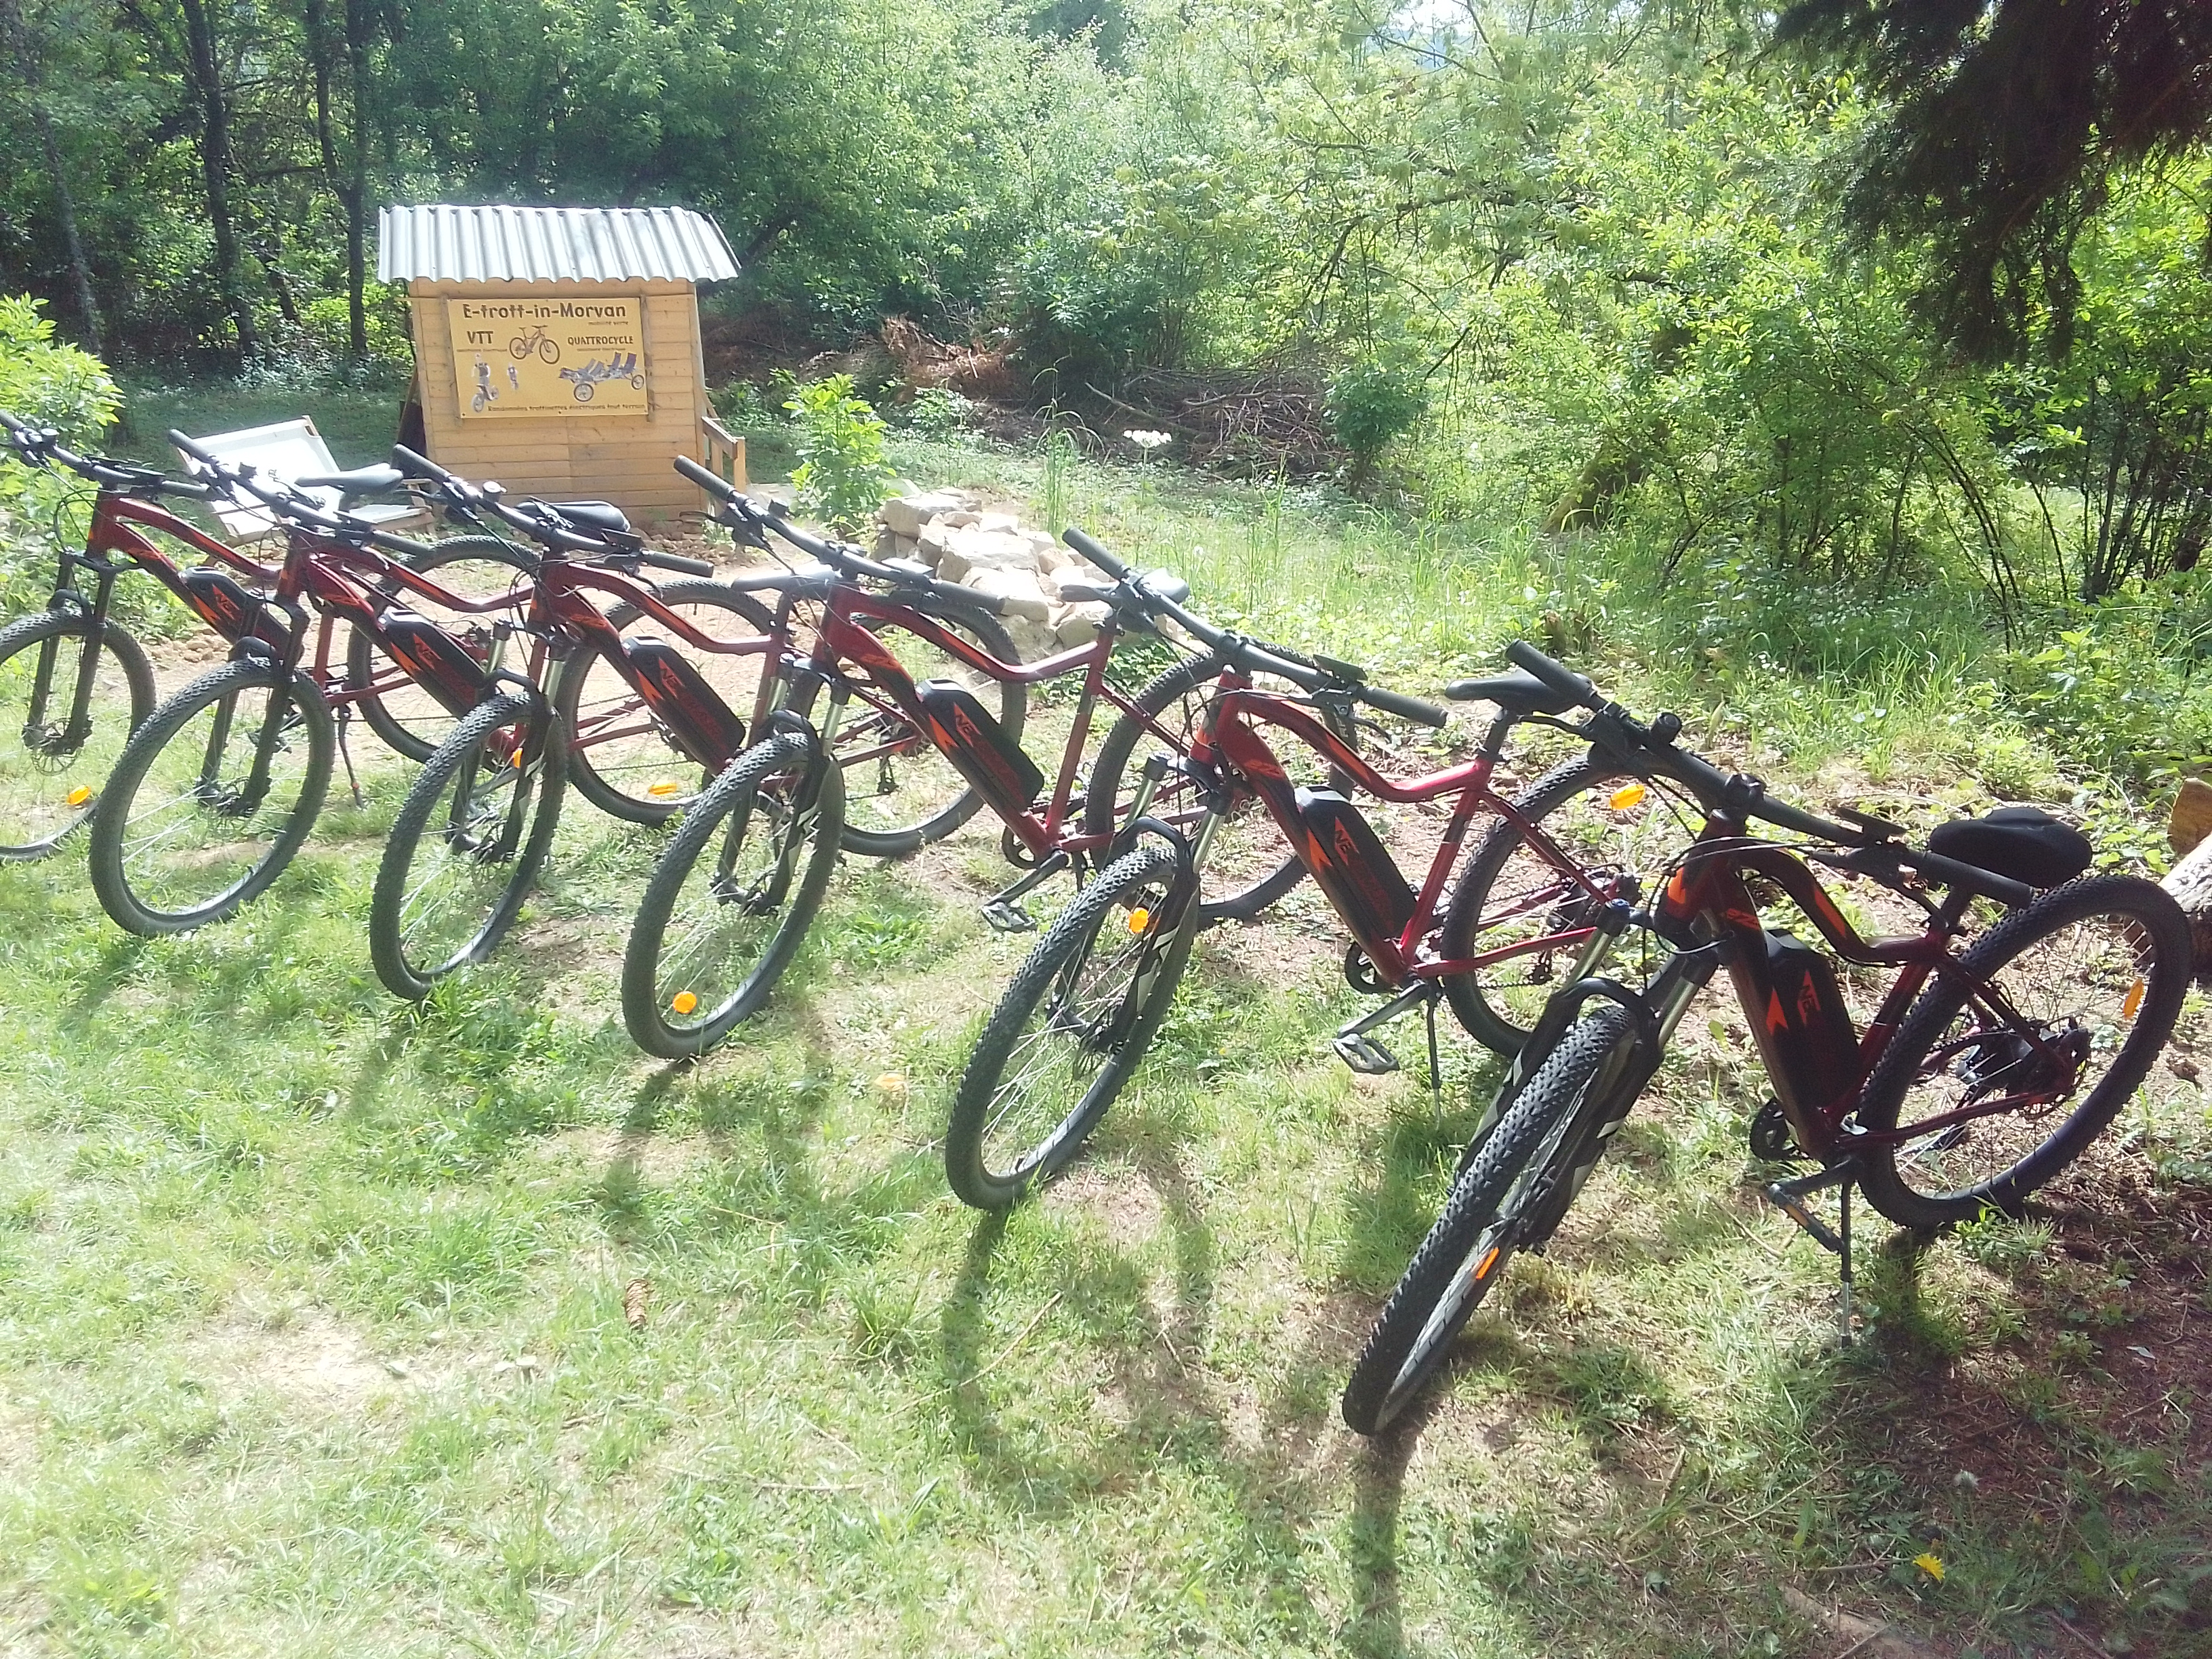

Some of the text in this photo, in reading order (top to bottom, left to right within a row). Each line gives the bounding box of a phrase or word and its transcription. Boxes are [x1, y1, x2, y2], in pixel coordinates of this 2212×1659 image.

[463, 302, 626, 319] E-trott-in-Morvan
[467, 330, 493, 344] VTT
[568, 335, 634, 346] QUATTROCYCLE
